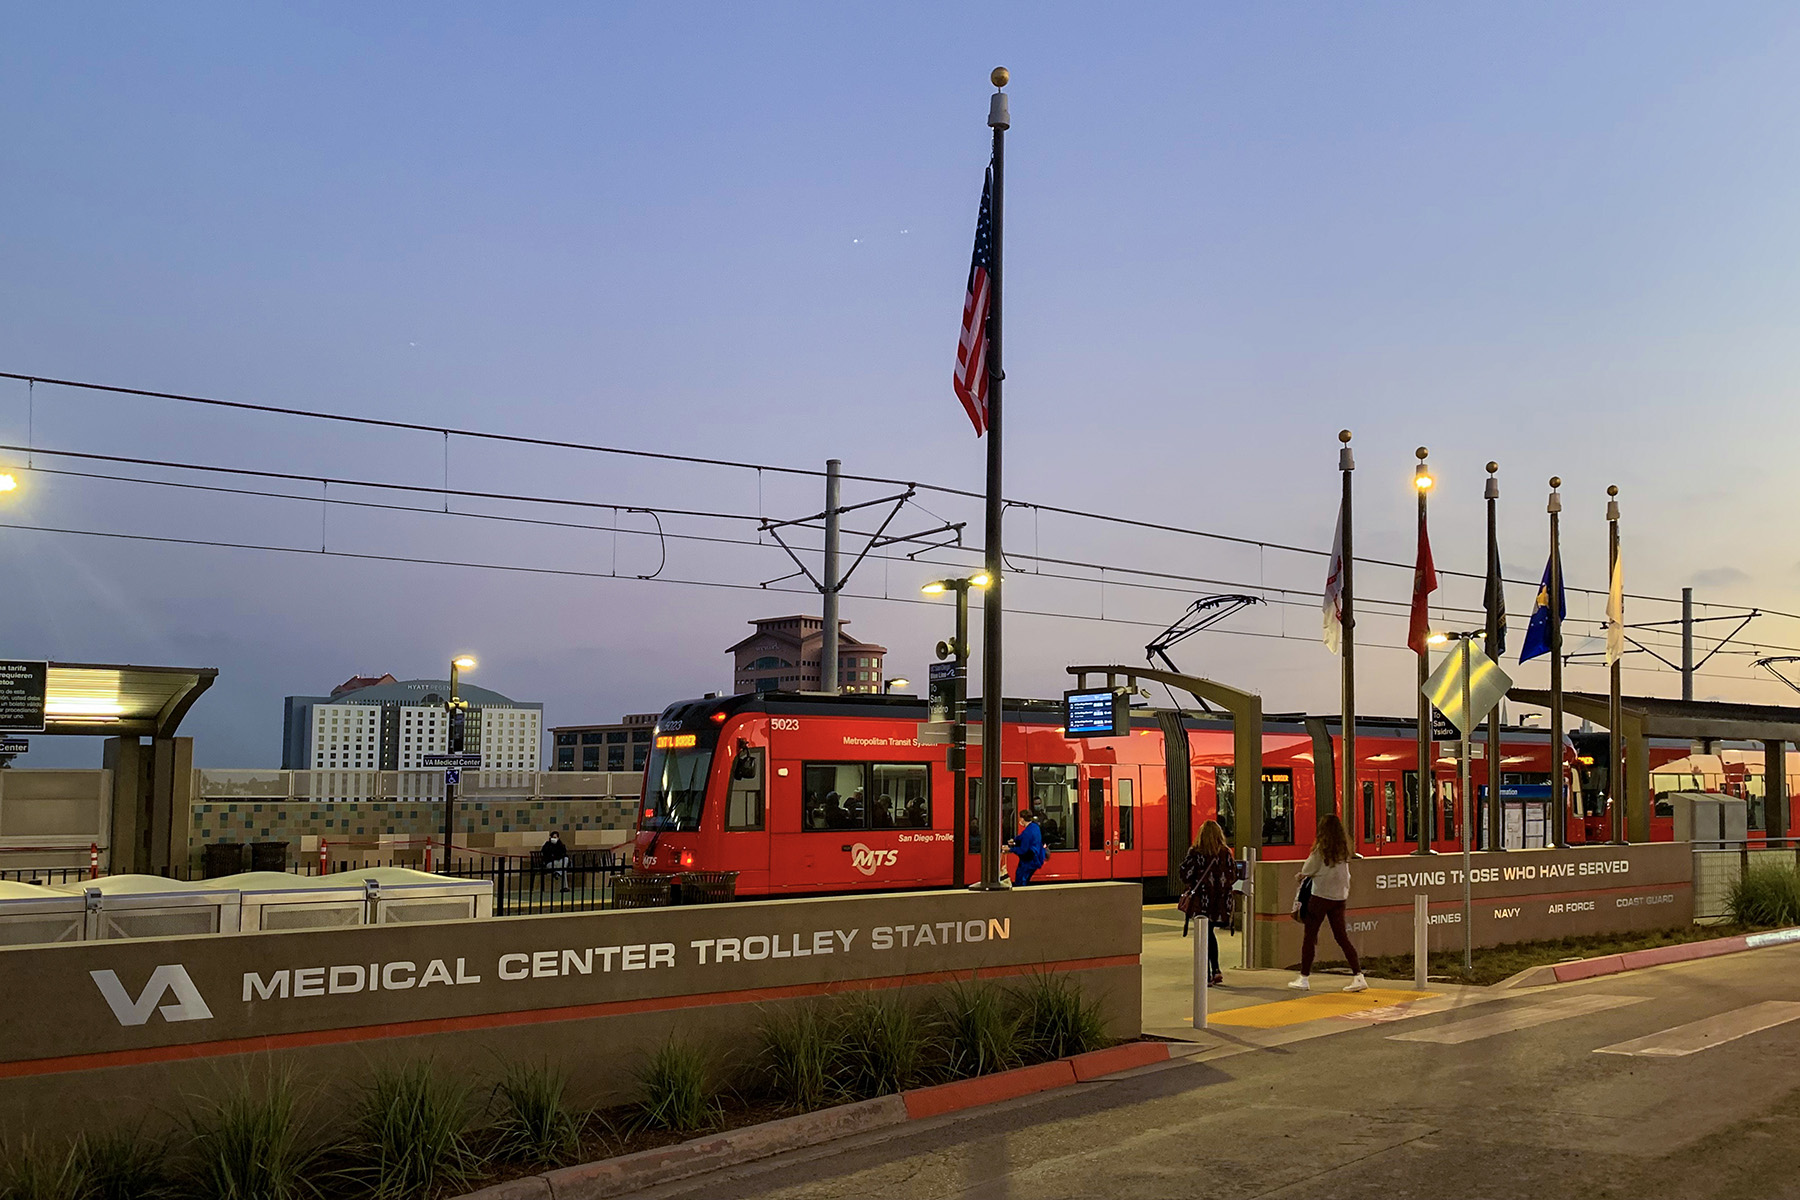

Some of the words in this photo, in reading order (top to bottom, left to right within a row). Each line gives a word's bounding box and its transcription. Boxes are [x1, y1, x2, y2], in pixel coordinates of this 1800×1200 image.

[930, 684, 937, 692] To
[930, 695, 941, 703] San
[930, 705, 948, 714] Ysidro
[771, 719, 799, 730] 5023
[843, 737, 888, 746] Metropolitan
[888, 738, 911, 746] Transit
[898, 834, 912, 842] San
[914, 834, 934, 843] Diego
[852, 850, 898, 866] MTS
[1376, 871, 1446, 889] SERVING
[1504, 866, 1536, 880] WHO
[1540, 864, 1575, 878] HAVE
[1579, 861, 1629, 875] SERVED
[1414, 913, 1461, 926] ARINES
[1494, 908, 1521, 918] NAVY
[1548, 904, 1563, 914] AIR
[1566, 902, 1595, 912] FORCE
[1616, 897, 1644, 907] COAST
[1646, 895, 1674, 904] GUARD
[89, 964, 214, 1026] VA
[242, 958, 481, 1001] MEDICAL
[498, 943, 676, 980] CENTER
[691, 929, 859, 965] TROLLEY
[871, 918, 1010, 950] STATION
